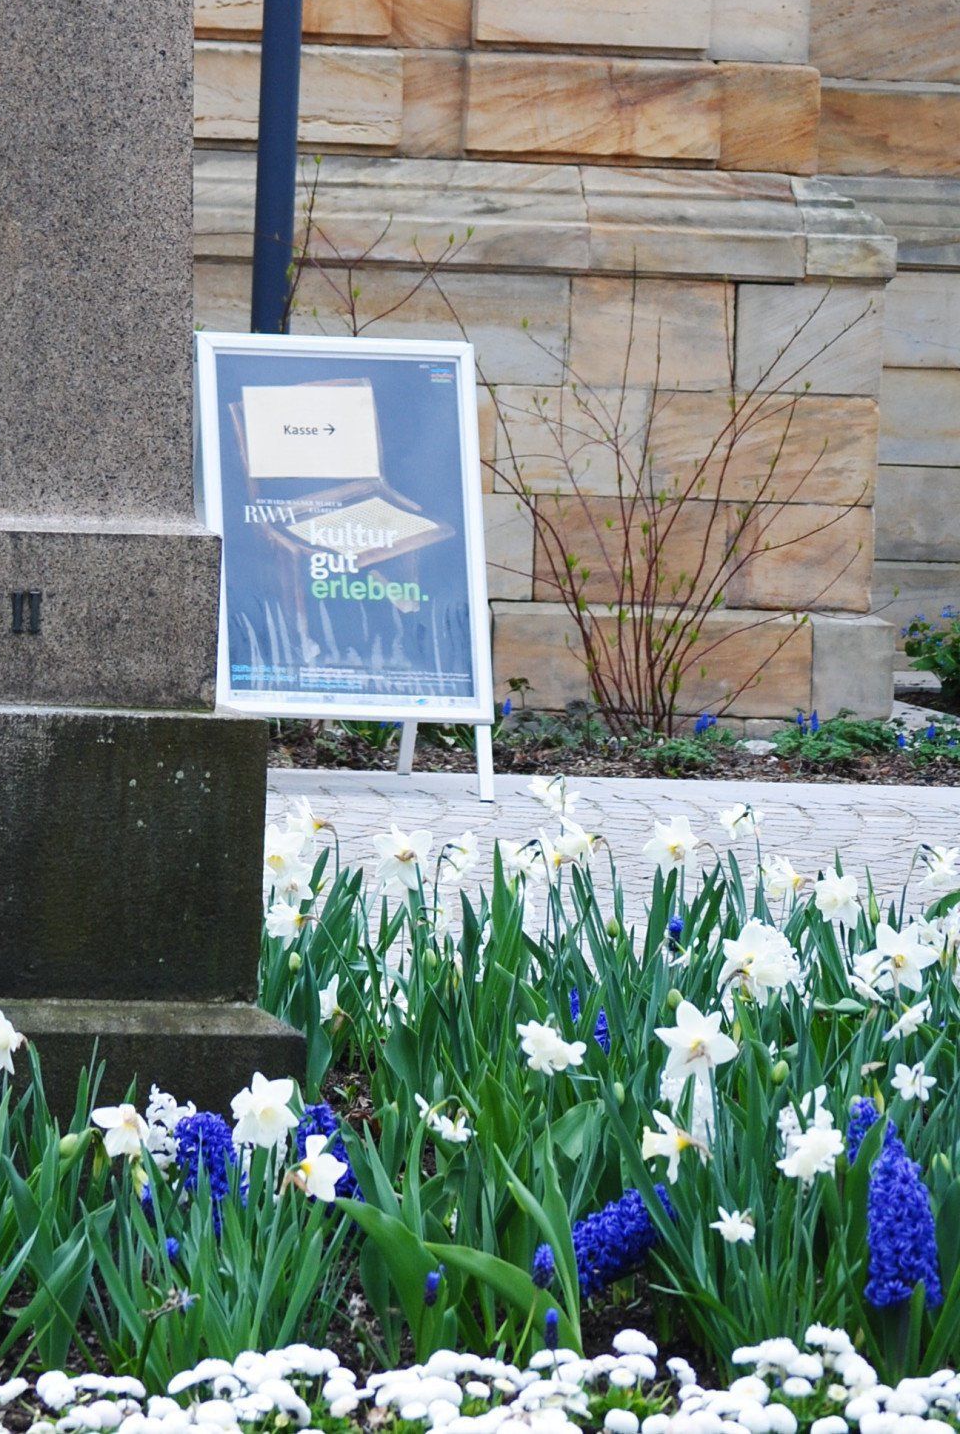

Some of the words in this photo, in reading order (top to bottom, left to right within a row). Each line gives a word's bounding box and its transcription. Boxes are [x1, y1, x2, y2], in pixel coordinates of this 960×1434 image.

[283, 424, 318, 435] Kasse
[310, 521, 398, 547] kultur
[310, 550, 359, 580] gut
[311, 574, 429, 601] erleben.
[12, 588, 41, 633] II
